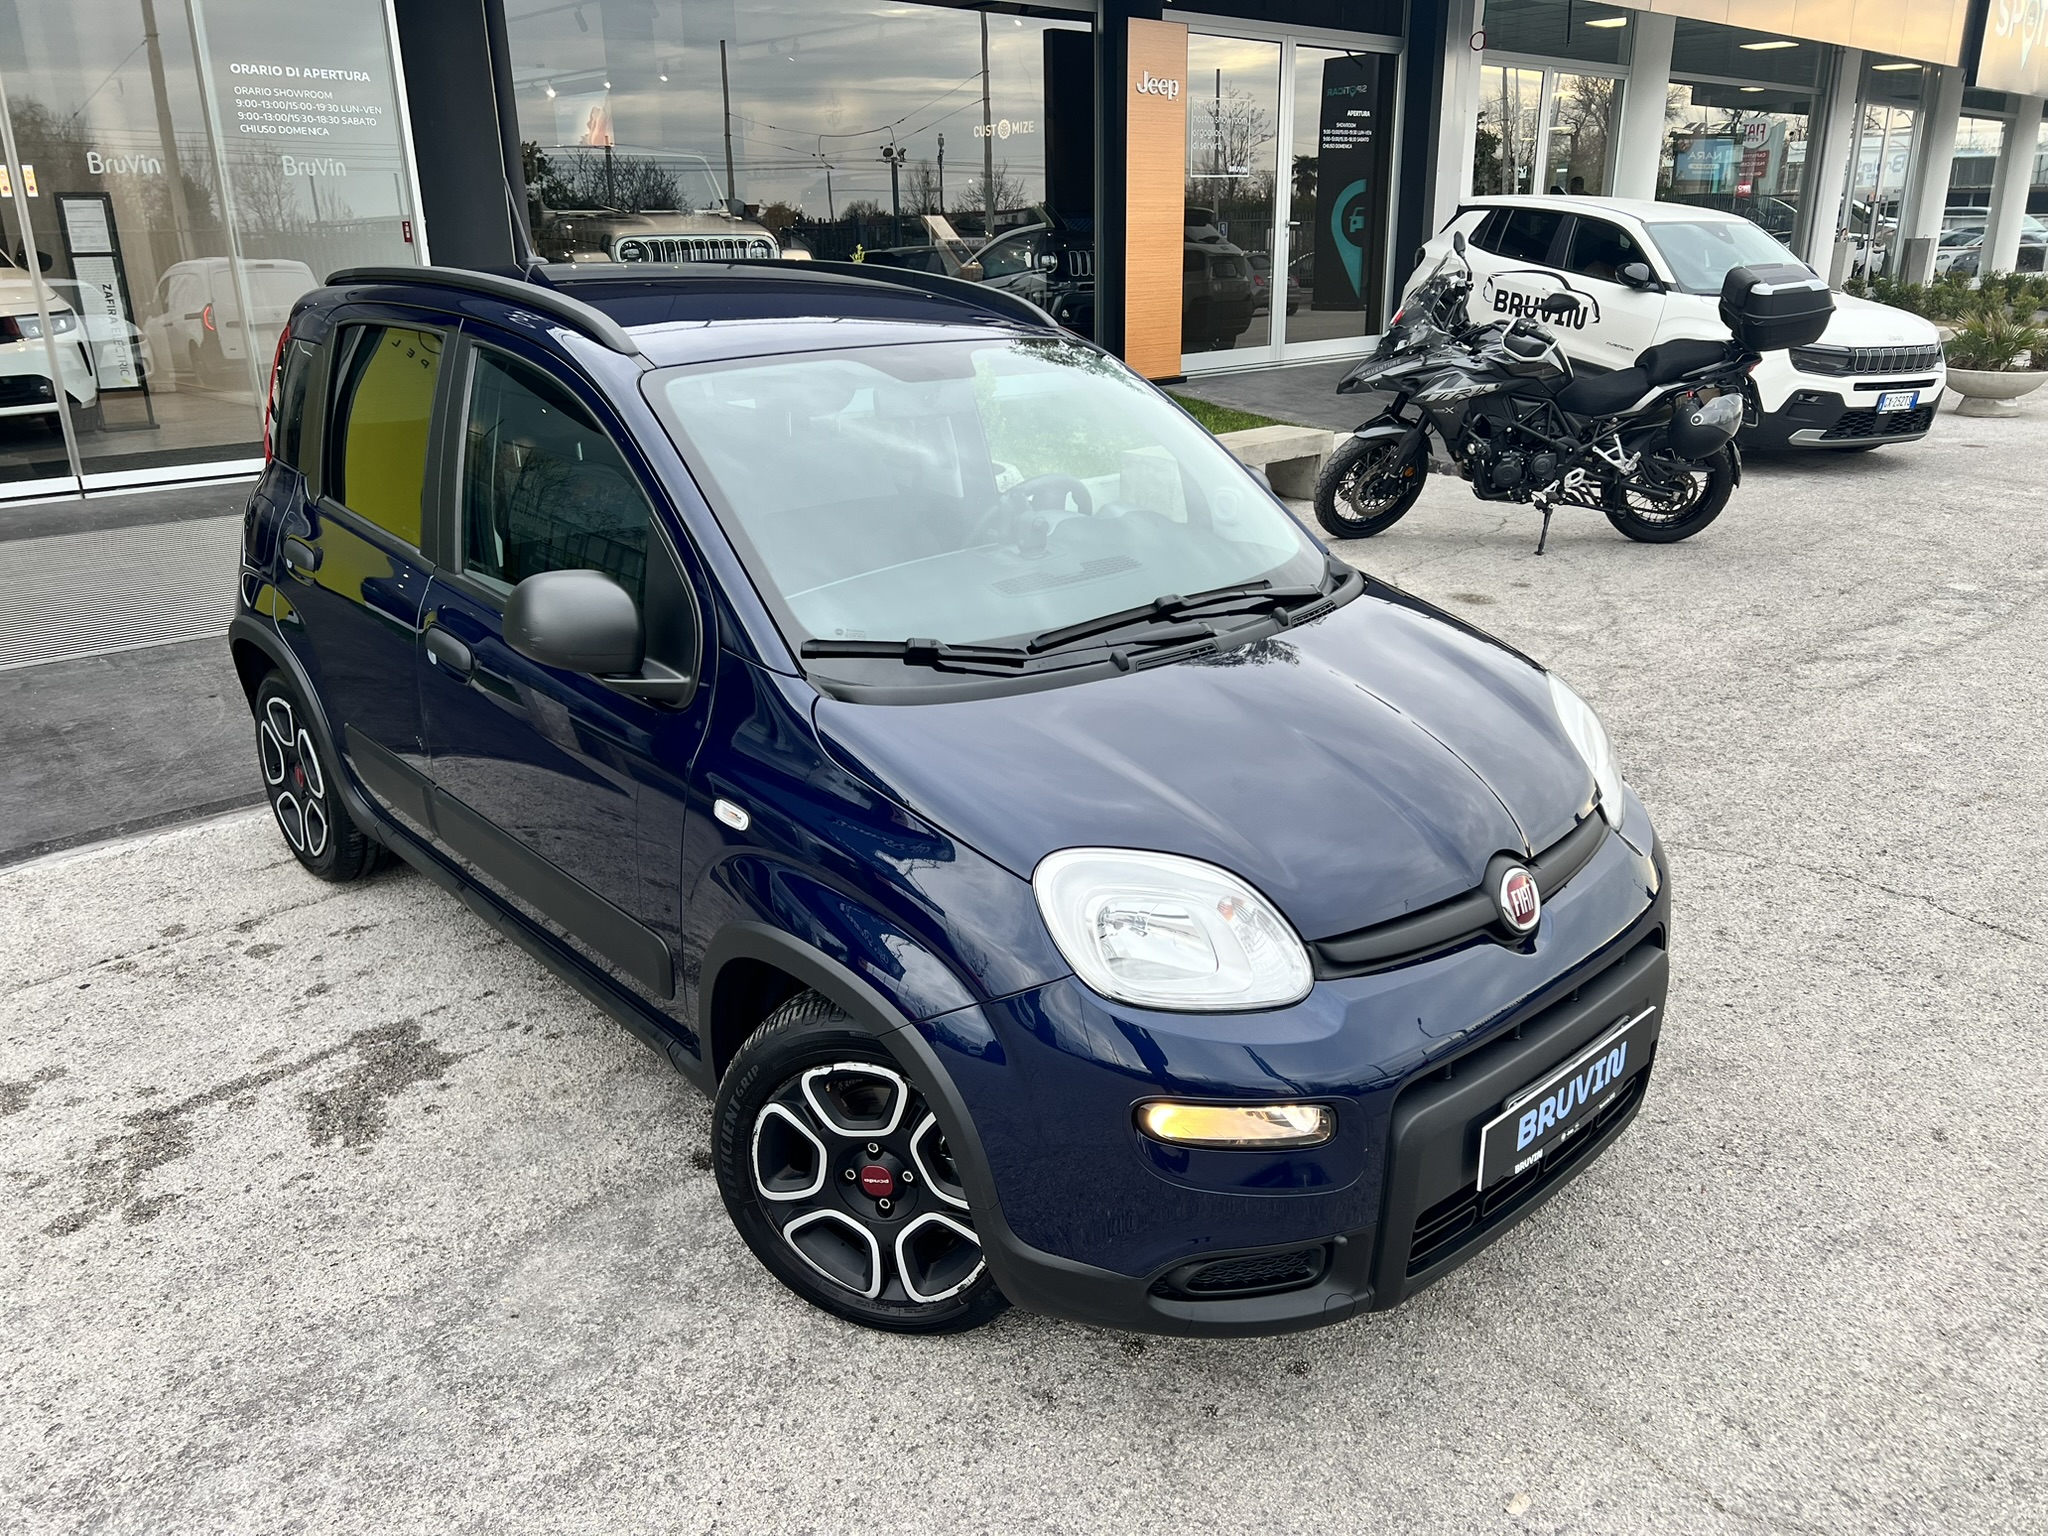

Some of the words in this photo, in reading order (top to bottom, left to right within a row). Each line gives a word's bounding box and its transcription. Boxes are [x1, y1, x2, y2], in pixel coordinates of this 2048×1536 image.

[230, 63, 282, 76] ORARIO
[286, 66, 300, 77] DI
[303, 68, 371, 82] APERTURA
[234, 86, 271, 96] ORARIO
[273, 88, 333, 99] SHOWROOM
[1136, 70, 1179, 100] Jeep
[340, 105, 382, 115] LUN-VEN
[240, 124, 276, 134] CHIUSO
[341, 117, 377, 126] SABATO
[86, 151, 161, 175] BruVin
[281, 155, 347, 177] BruVin
[101, 283, 119, 325] ZAFIRA
[111, 327, 130, 377] ELECTRIC
[1361, 359, 1401, 377] ADVENTURE
[1510, 883, 1534, 917] FIAT
[1516, 1040, 1628, 1152] BRUVIN
[1514, 1148, 1544, 1175] BRUVIN
